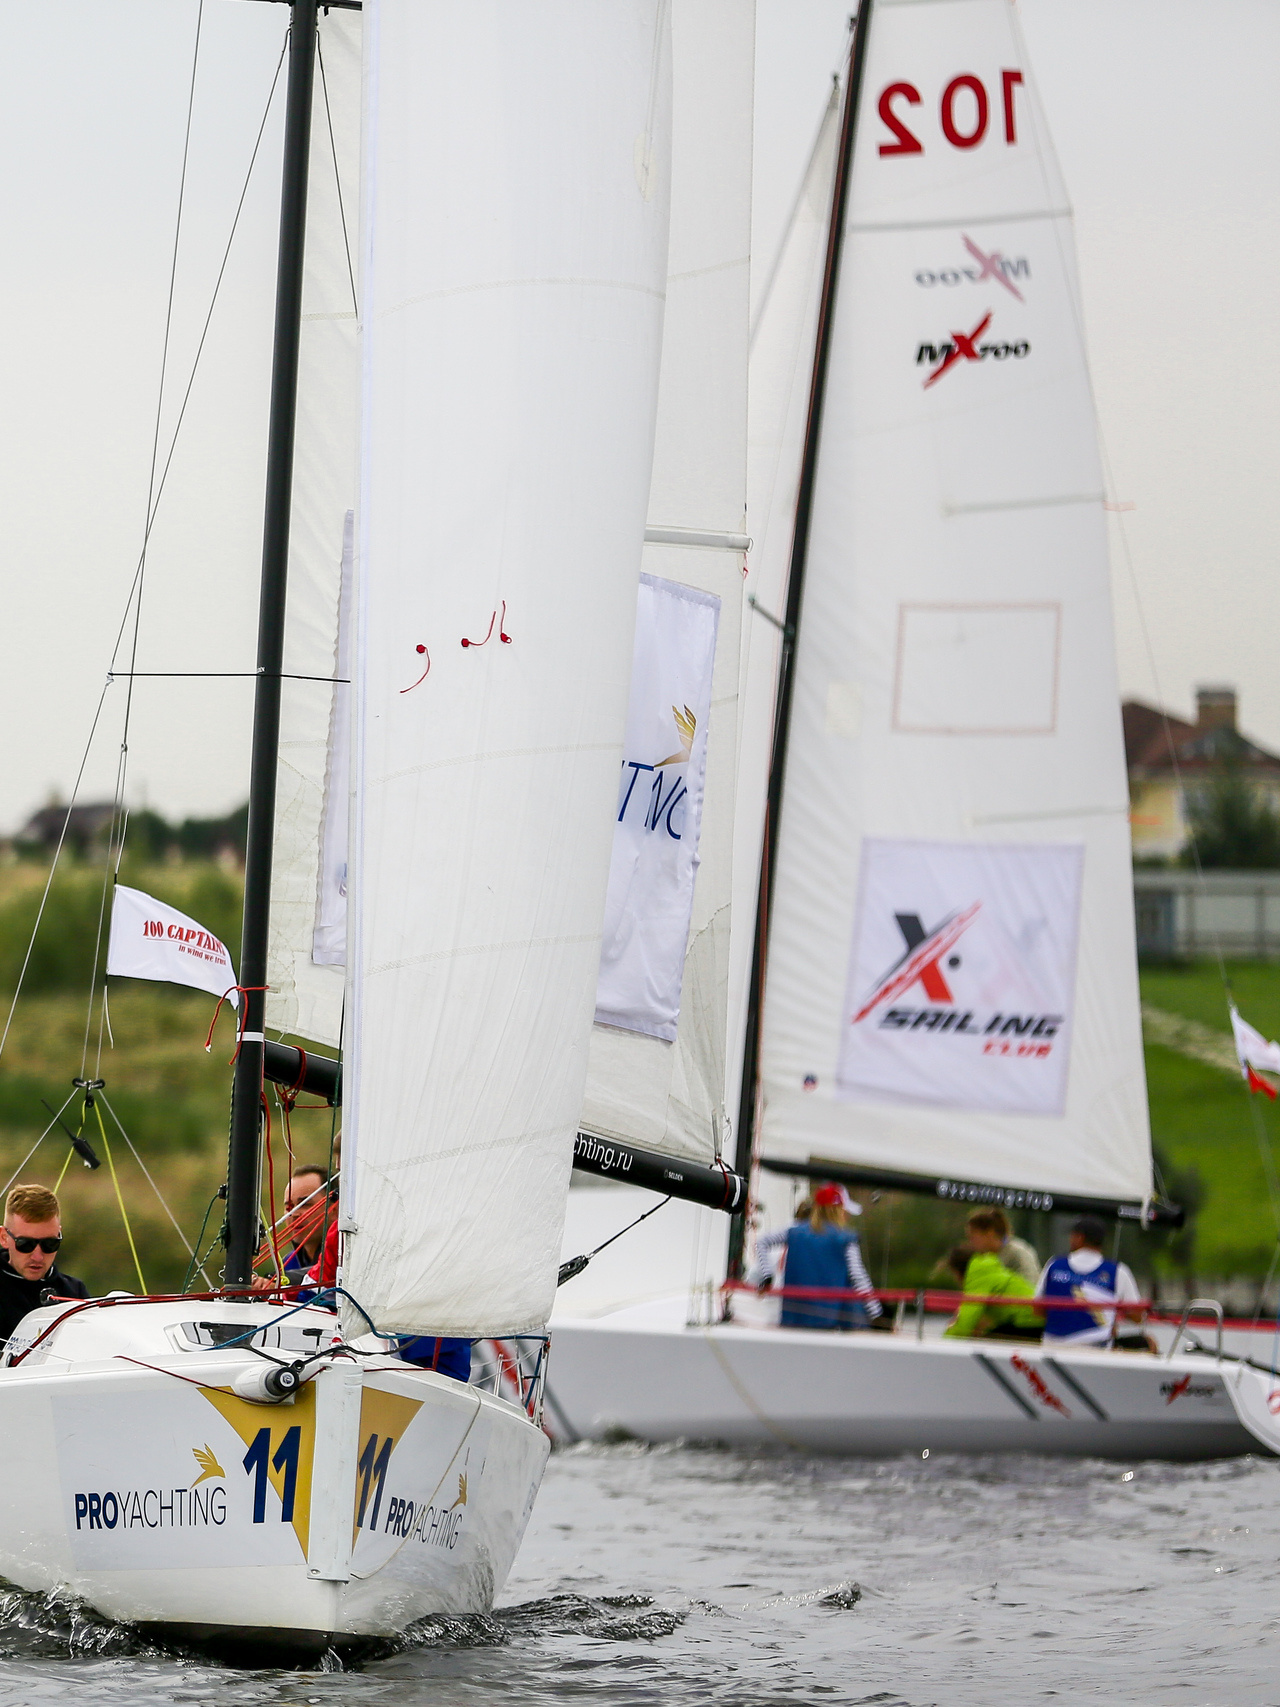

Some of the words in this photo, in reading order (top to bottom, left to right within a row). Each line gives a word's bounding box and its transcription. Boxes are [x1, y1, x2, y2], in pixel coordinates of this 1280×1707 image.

[143, 920, 164, 938] 100
[880, 1008, 1064, 1039] SAILING
[242, 1425, 302, 1524] 11
[356, 1433, 393, 1532] 11
[75, 1486, 227, 1530] PROYACHTING
[384, 1496, 464, 1550] PROYACHTING
